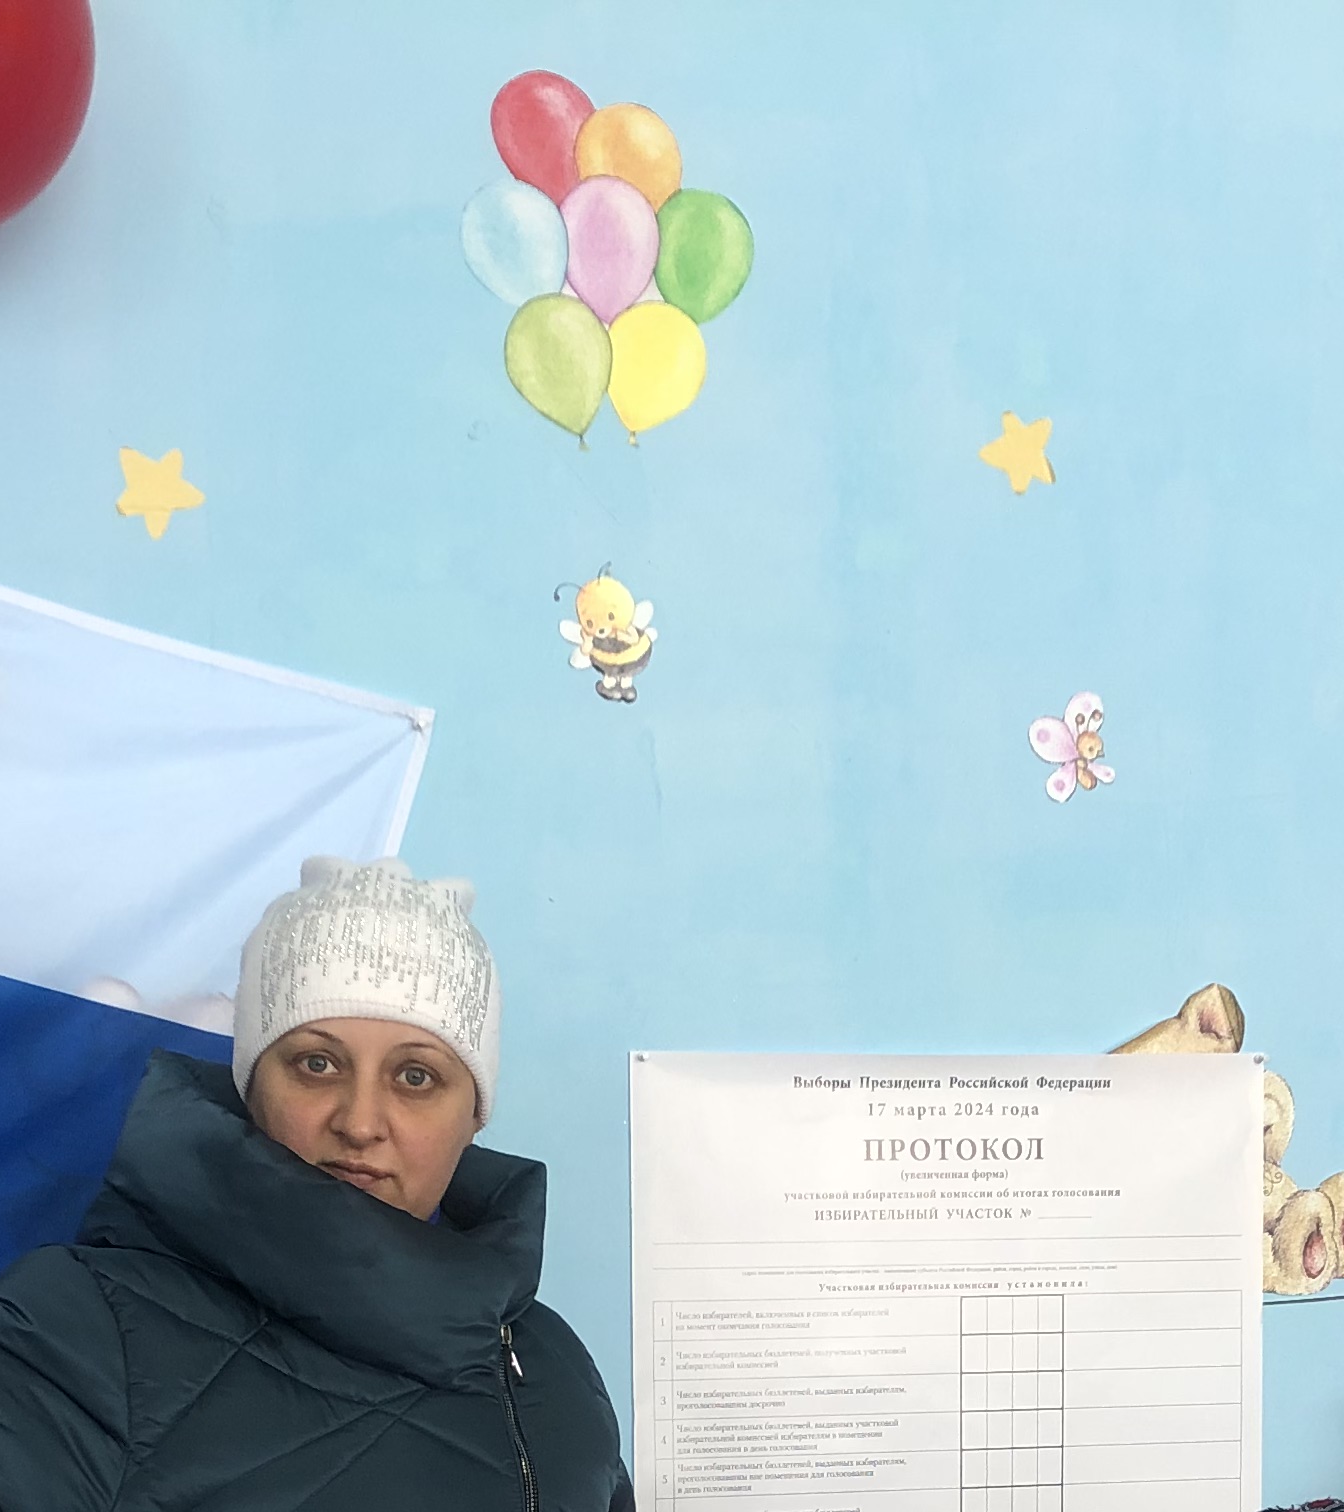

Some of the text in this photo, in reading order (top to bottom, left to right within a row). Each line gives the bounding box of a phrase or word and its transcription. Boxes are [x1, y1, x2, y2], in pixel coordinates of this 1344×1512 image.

[793, 1076, 1110, 1091] Выборы Президента Российской Федерации
[869, 1102, 1039, 1120] 17 марта 2024 года
[863, 1137, 1044, 1162] ПРОТОКОЛ
[900, 1170, 1010, 1182] (увеличенная форма)
[784, 1190, 848, 1203] участковой
[852, 1189, 936, 1202] избирательной
[940, 1191, 992, 1199] комиссии
[996, 1188, 1009, 1198] об
[814, 1208, 1031, 1221] ИЗБИРАТЕЛЬНЫЙ УЧАСТОК №
